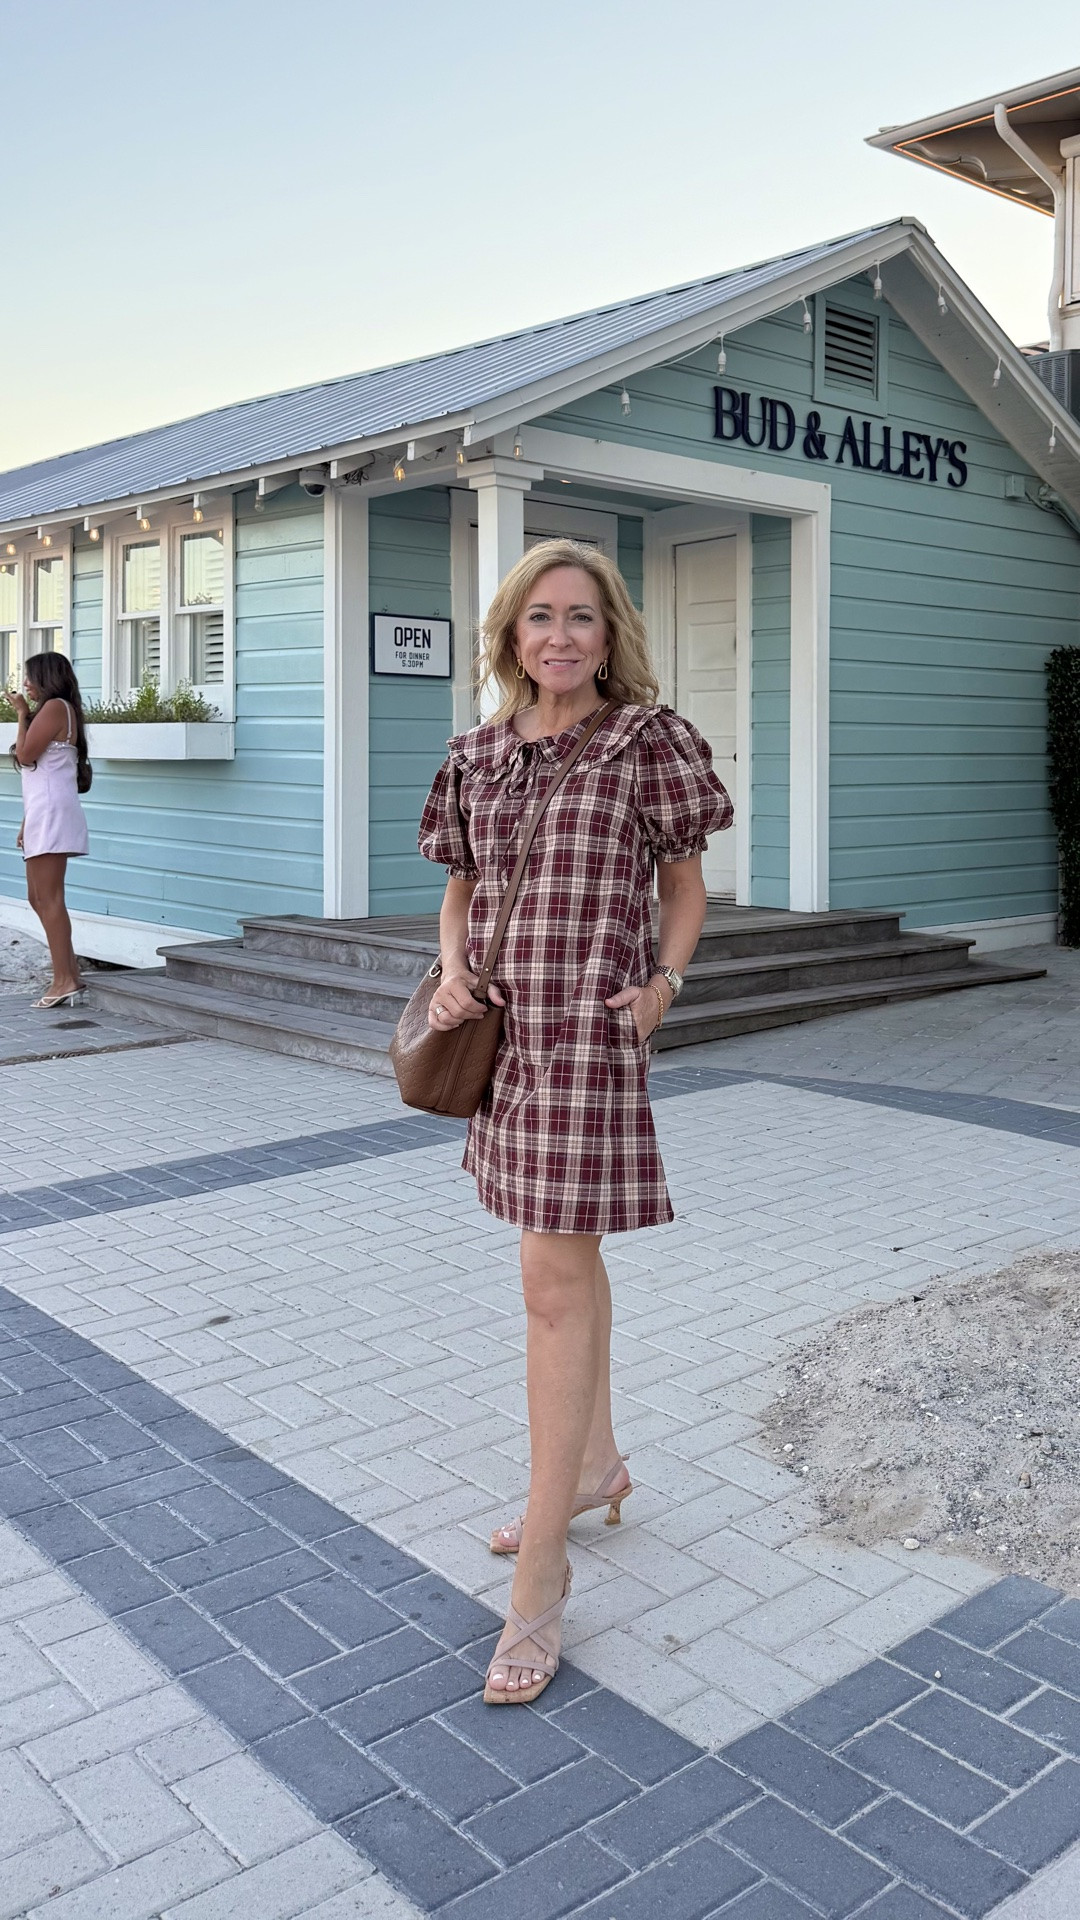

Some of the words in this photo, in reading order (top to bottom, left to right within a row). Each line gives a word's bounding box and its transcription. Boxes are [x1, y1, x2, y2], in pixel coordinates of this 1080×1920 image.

[713, 385, 796, 451] BUD
[802, 410, 829, 460] &
[835, 415, 968, 488] ALLEY'S
[394, 626, 431, 649] OPEN
[395, 651, 407, 659] FOR
[409, 652, 430, 660] DINNER
